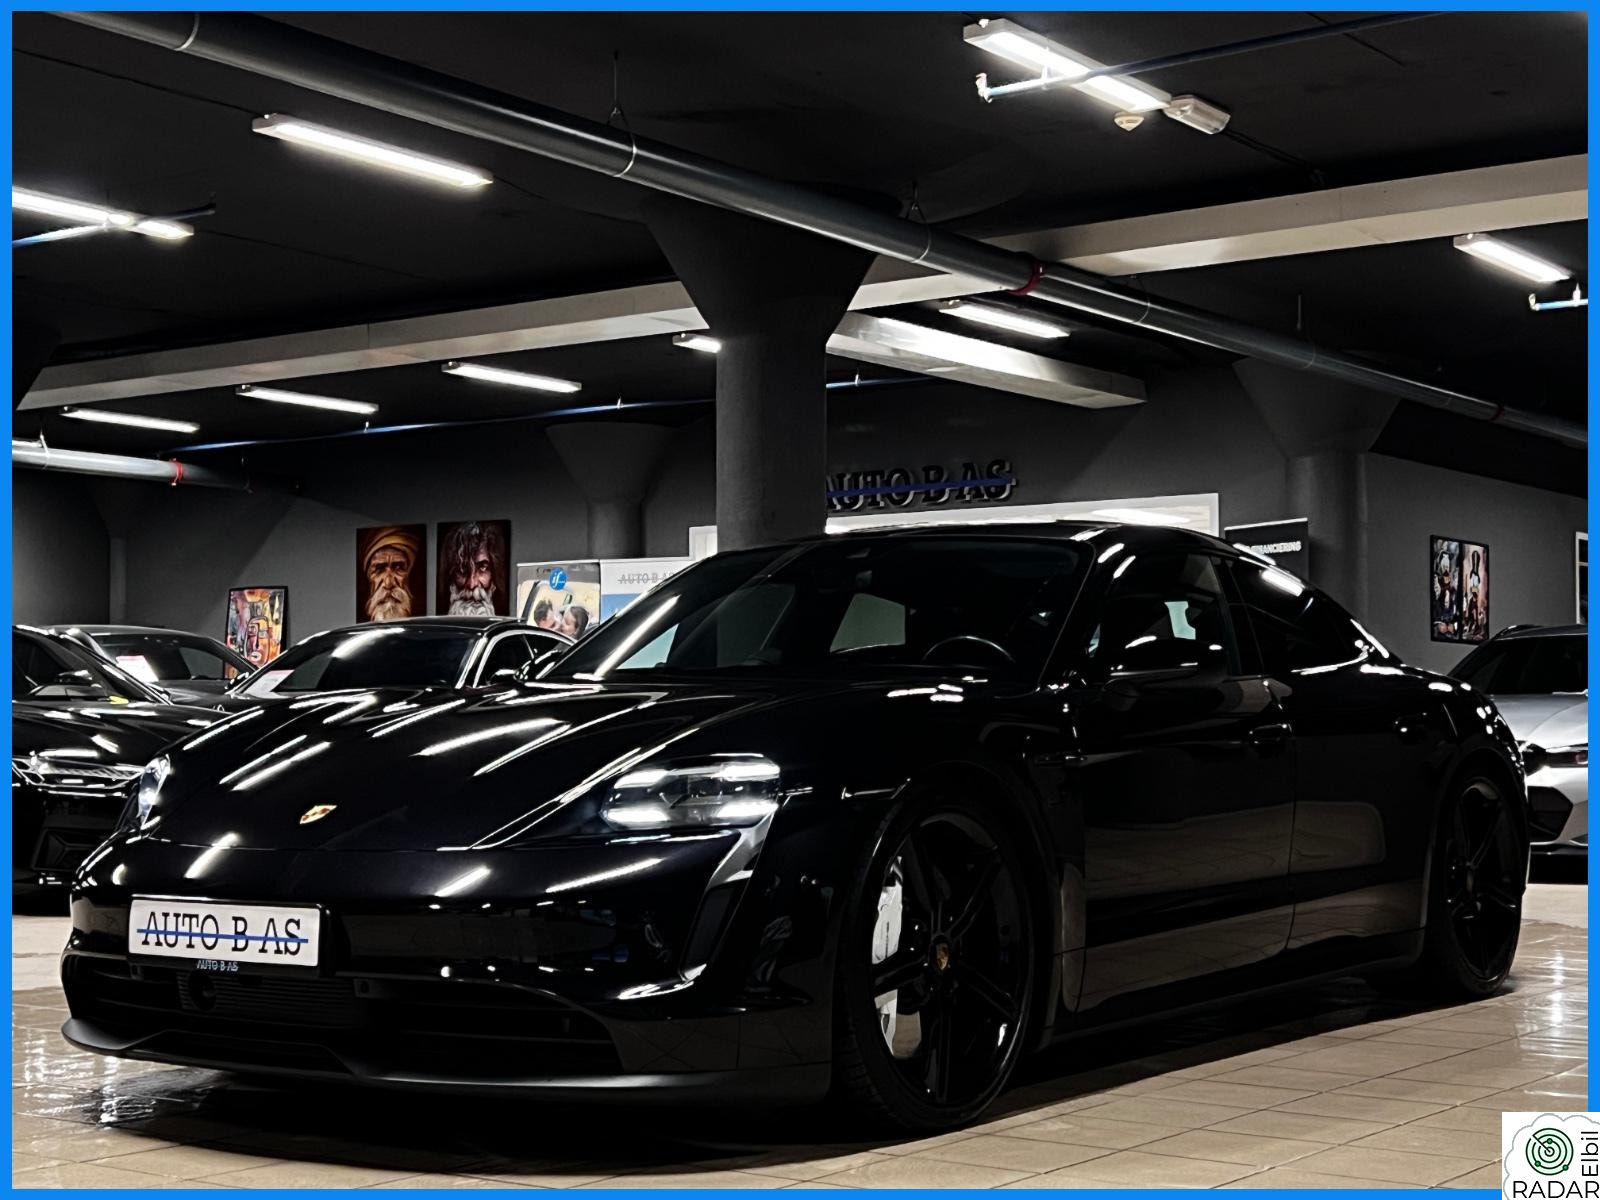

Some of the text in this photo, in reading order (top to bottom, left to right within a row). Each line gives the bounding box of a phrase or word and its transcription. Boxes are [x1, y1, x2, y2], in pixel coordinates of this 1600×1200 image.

[921, 464, 951, 503] B
[956, 458, 1014, 502] AS
[619, 573, 649, 585] AUTO
[142, 911, 301, 956] AUTO B AS
[196, 959, 218, 971] AUTO
[226, 961, 239, 973] AS
